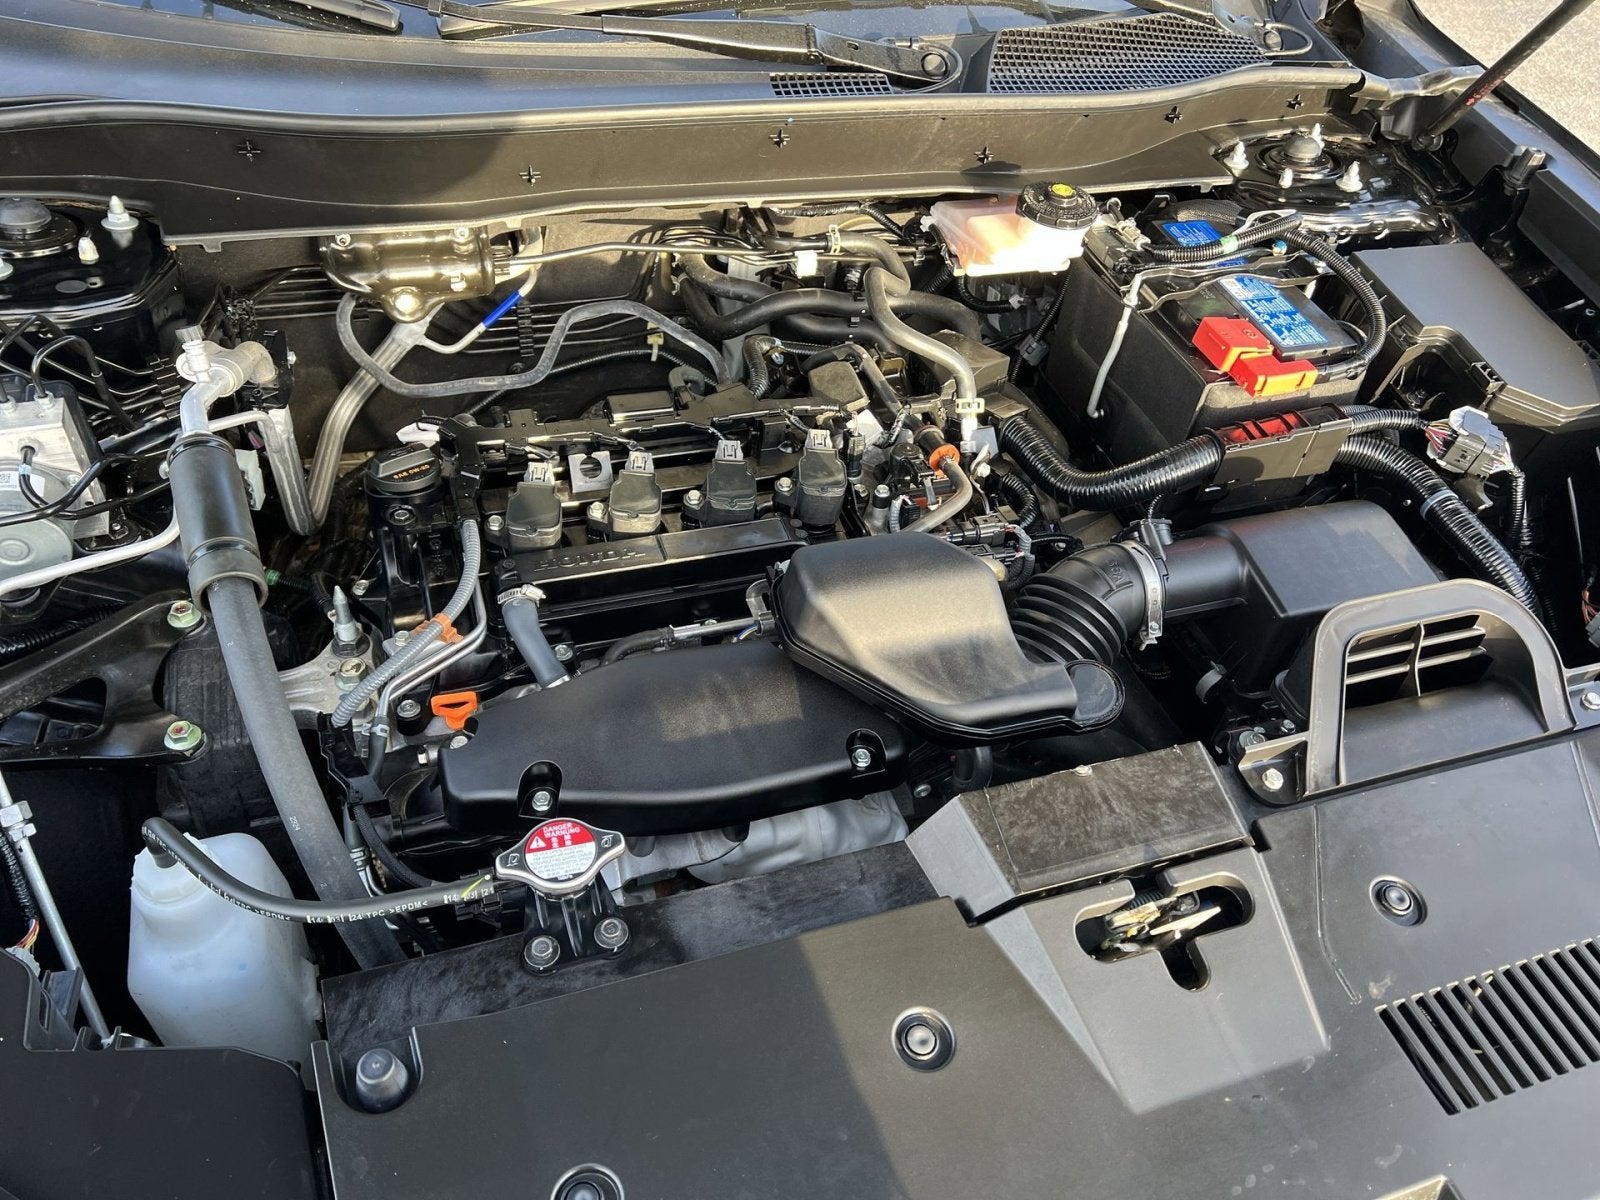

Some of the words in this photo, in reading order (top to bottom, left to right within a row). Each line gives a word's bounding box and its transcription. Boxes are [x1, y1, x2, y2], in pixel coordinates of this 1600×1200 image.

[534, 549, 646, 572] HONDA
[543, 822, 573, 834] DANGER
[366, 910, 385, 918] TPC
